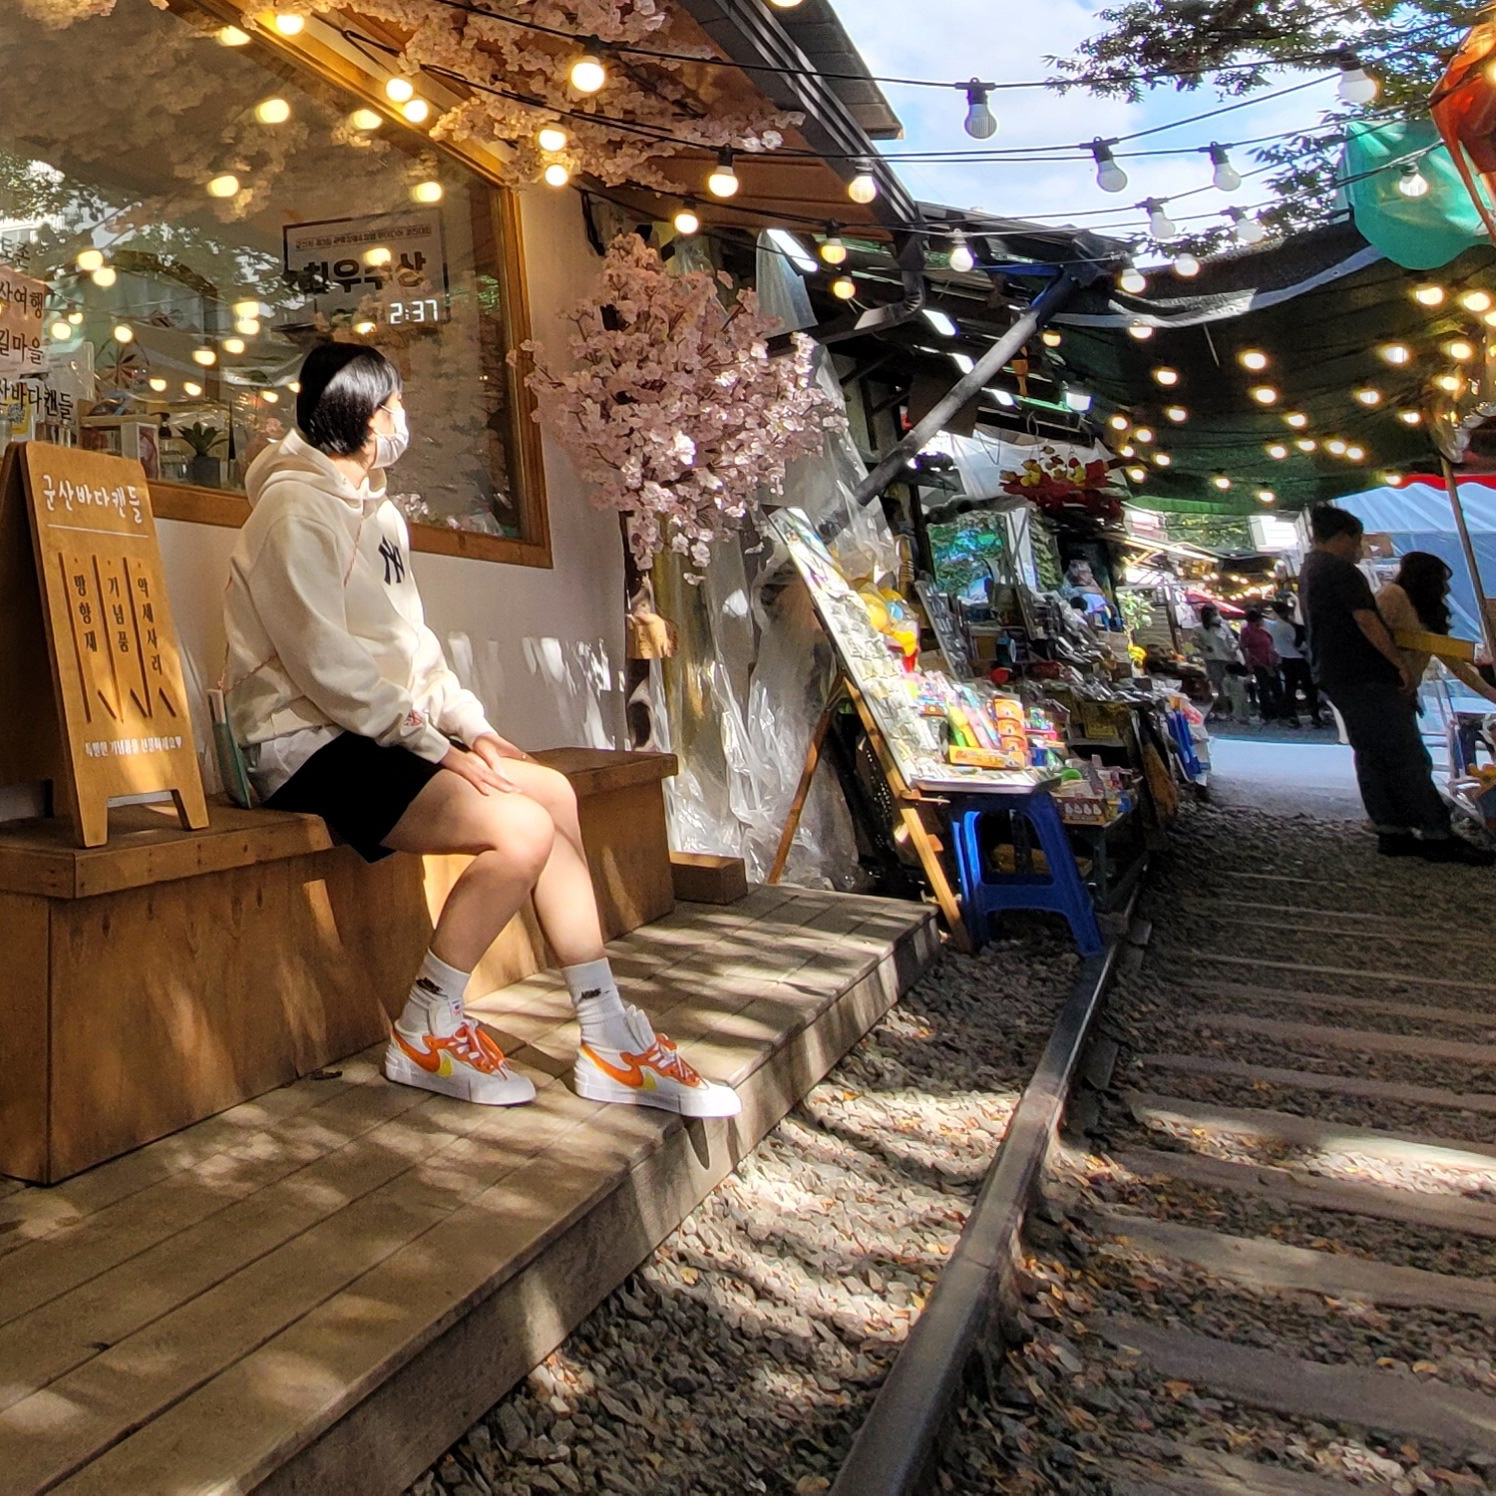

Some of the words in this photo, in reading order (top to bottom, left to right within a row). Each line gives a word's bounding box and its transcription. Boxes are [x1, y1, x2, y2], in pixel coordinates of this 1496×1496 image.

[390, 299, 439, 325] 2:37
[42, 474, 143, 524] 군산바다캔들
[74, 575, 97, 653] 방향제
[109, 576, 129, 653] 기념품
[137, 577, 163, 676] 악세사리
